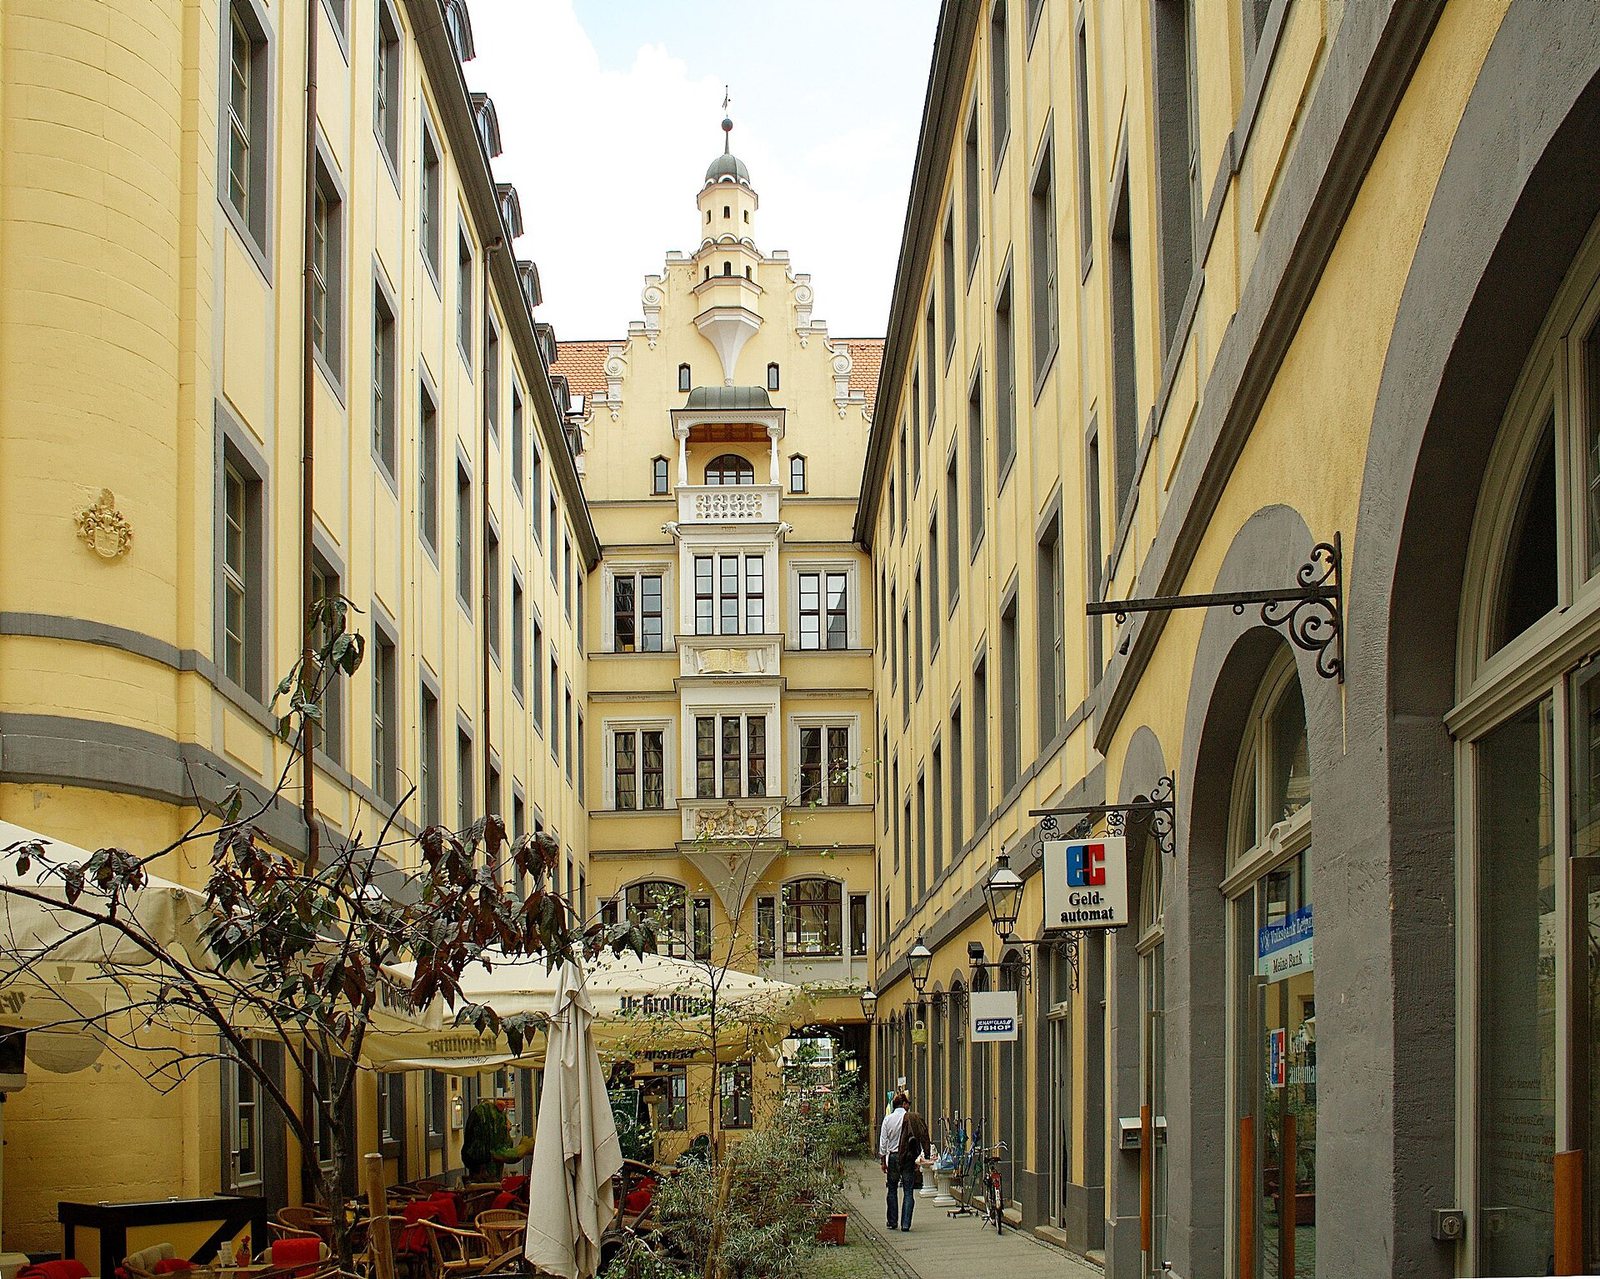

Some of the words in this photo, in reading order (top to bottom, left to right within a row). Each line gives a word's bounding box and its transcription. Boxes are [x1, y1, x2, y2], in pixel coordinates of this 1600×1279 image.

[1069, 892, 1104, 906] Geld-
[1061, 907, 1114, 922] automat
[1273, 957, 1288, 973] Meine
[1289, 950, 1303, 968] Bank
[1290, 1064, 1315, 1084] automa
